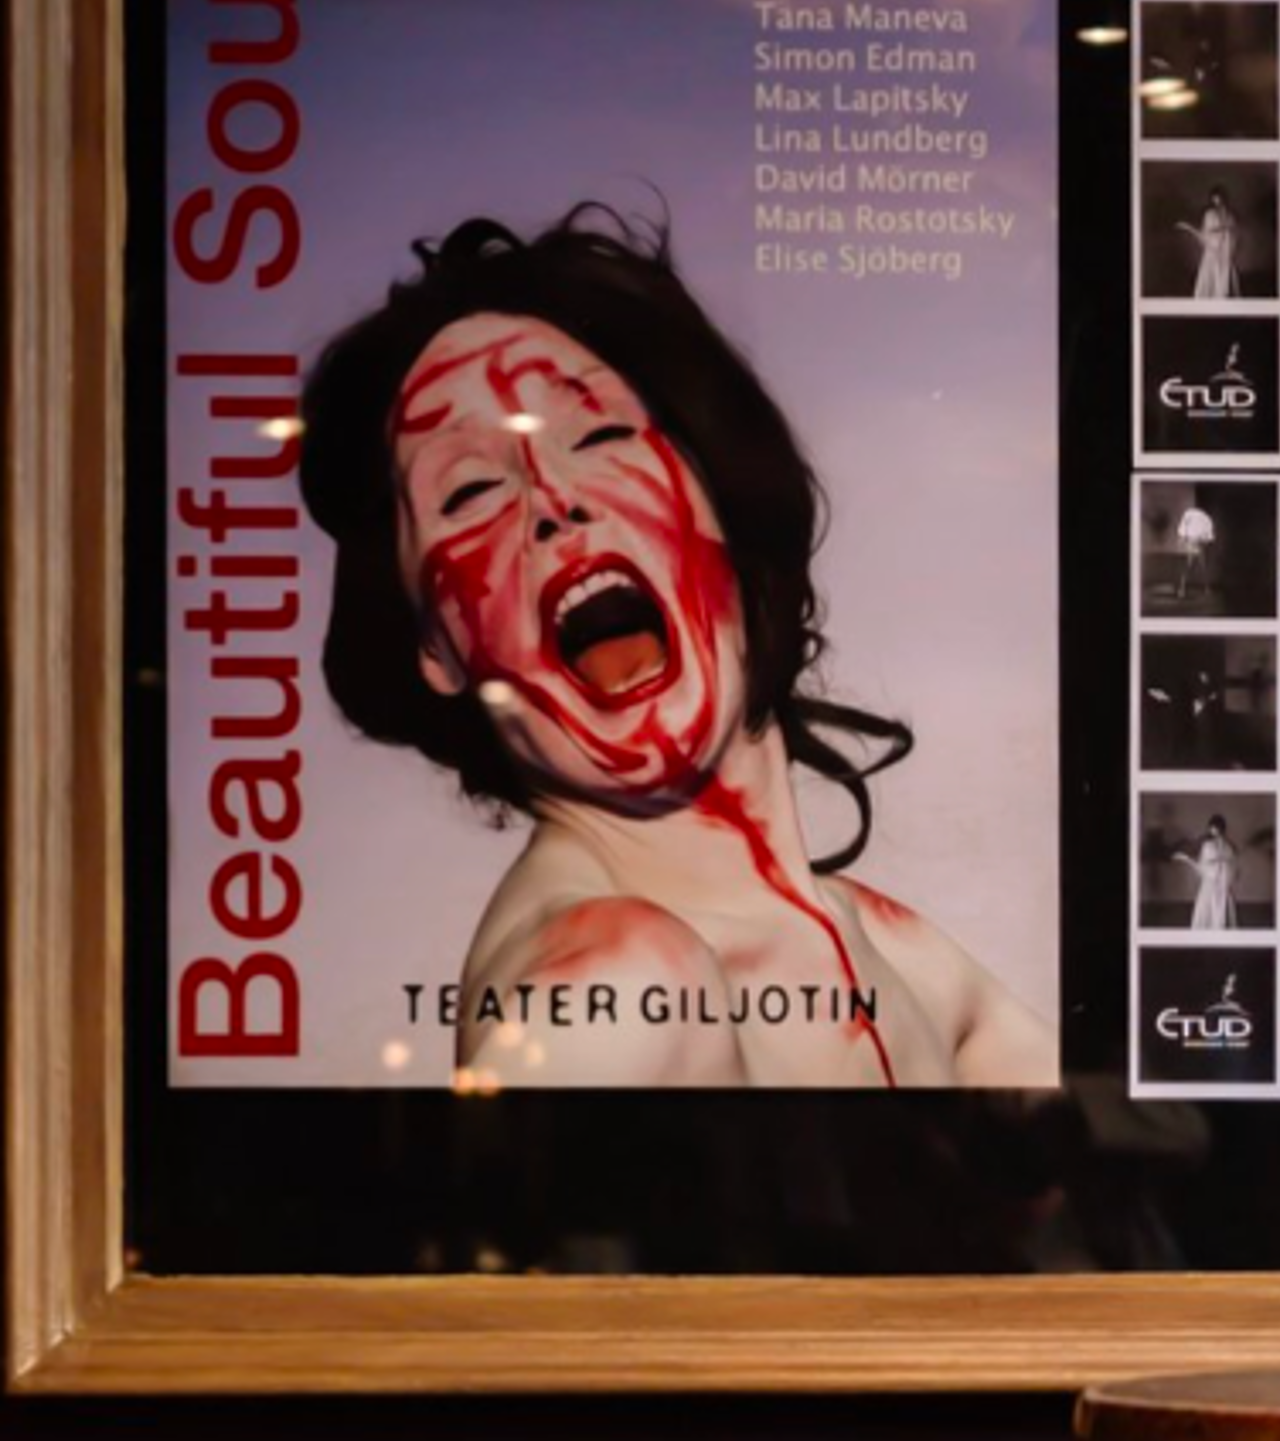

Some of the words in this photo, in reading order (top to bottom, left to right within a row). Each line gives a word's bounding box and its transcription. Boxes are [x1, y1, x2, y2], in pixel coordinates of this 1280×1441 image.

[754, 1, 833, 31] Tana
[845, 3, 968, 33] Maneva
[754, 42, 855, 71] Simon
[867, 43, 976, 72] Edman
[755, 83, 821, 111] Max
[833, 83, 969, 117] Lapitsky
[755, 124, 821, 152] Lina
[833, 124, 988, 158] Lundberg
[755, 164, 846, 193] David
[857, 164, 974, 193] Mörner
[856, 205, 1015, 239] Rostotsky
[755, 243, 828, 272] Elise
[839, 244, 962, 281] Sjöberg
[177, 354, 303, 1058] Beautiful
[402, 983, 617, 1026] TEATER
[639, 984, 877, 1025] GILJOTIN
